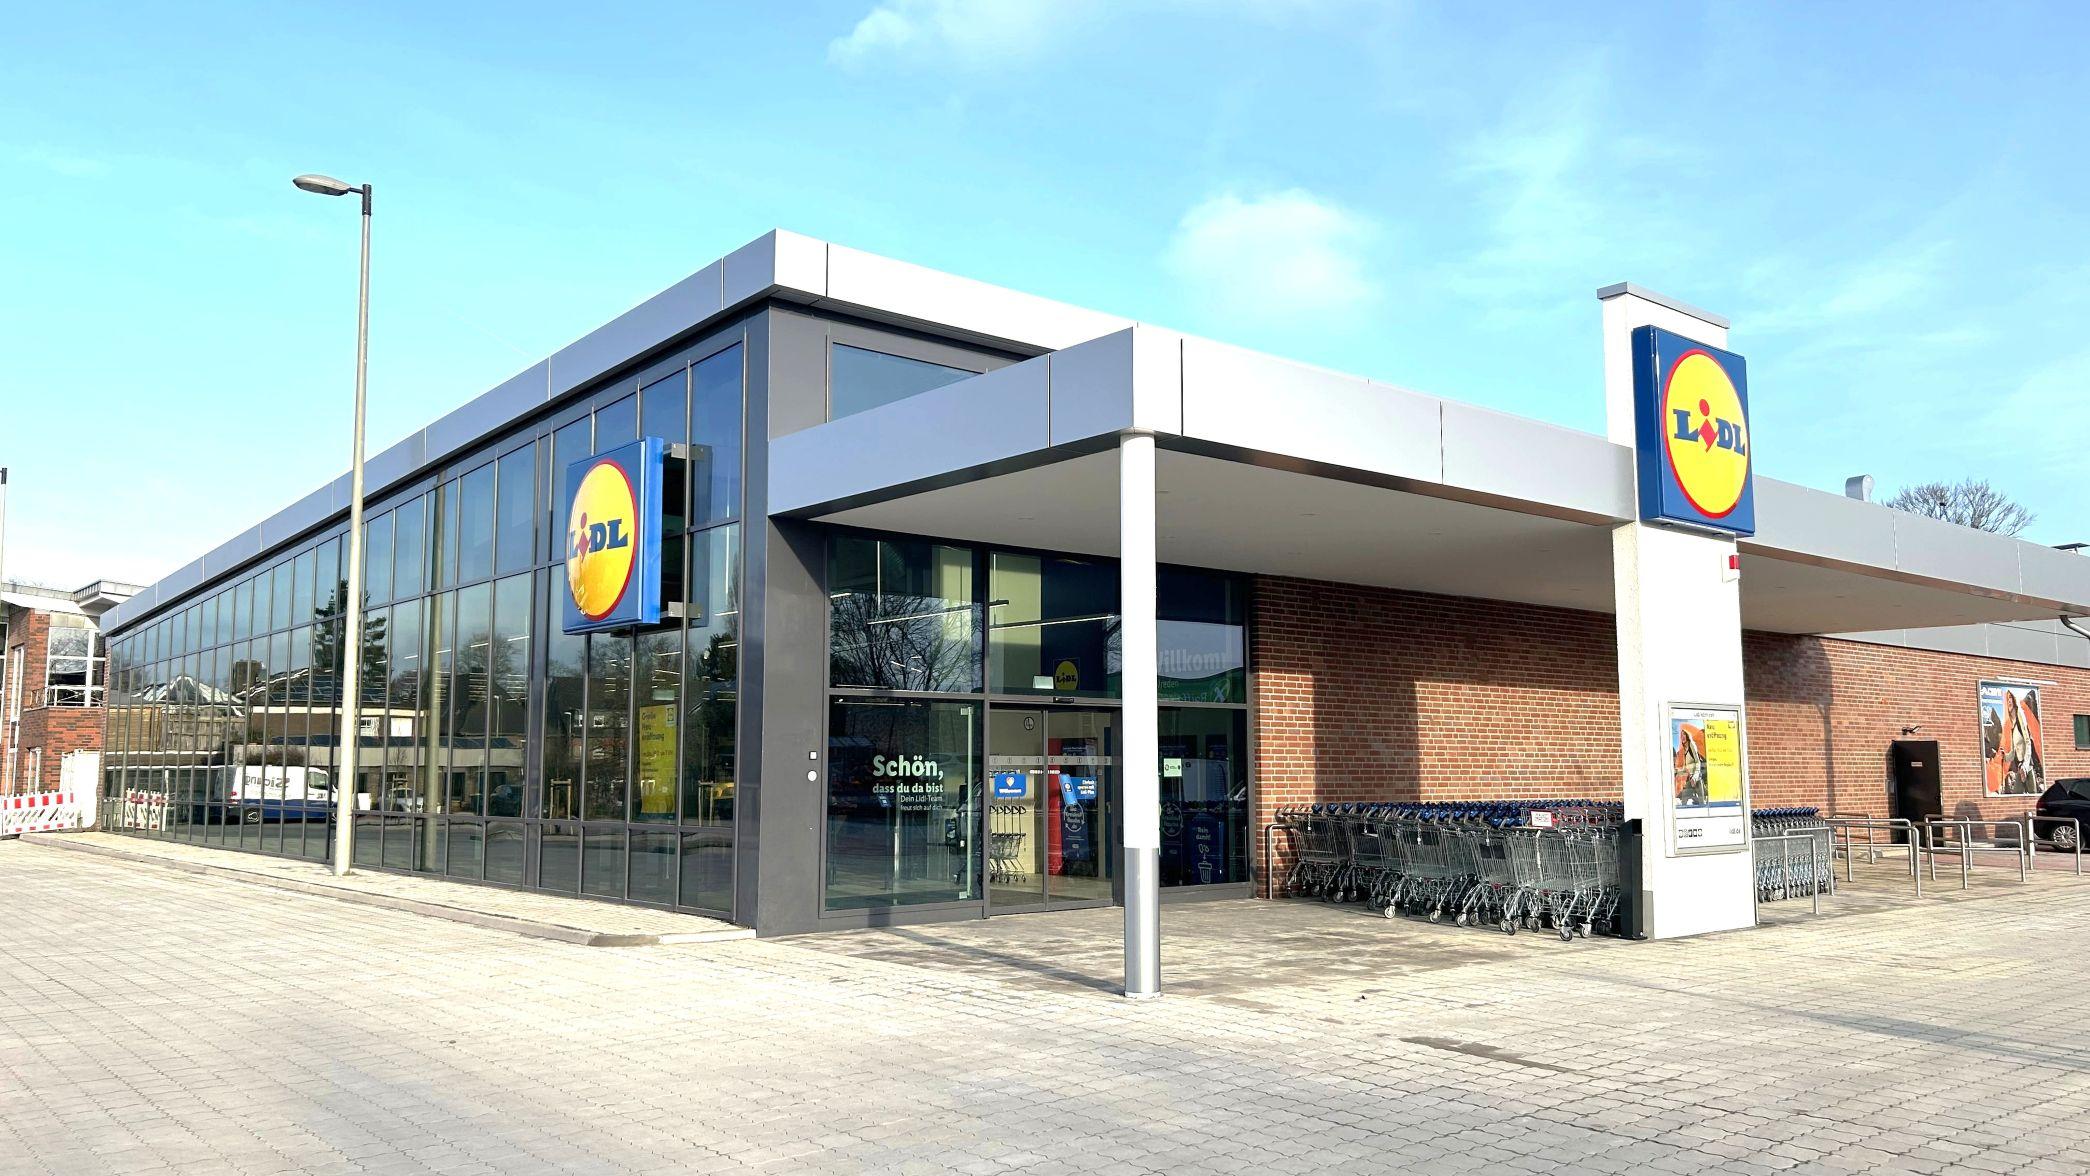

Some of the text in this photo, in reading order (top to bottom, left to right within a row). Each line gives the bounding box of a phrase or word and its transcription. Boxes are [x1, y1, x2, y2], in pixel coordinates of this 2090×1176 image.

[872, 754, 944, 781] Schön,
[872, 782, 944, 793] dass du da bist
[900, 795, 914, 803] Dein
